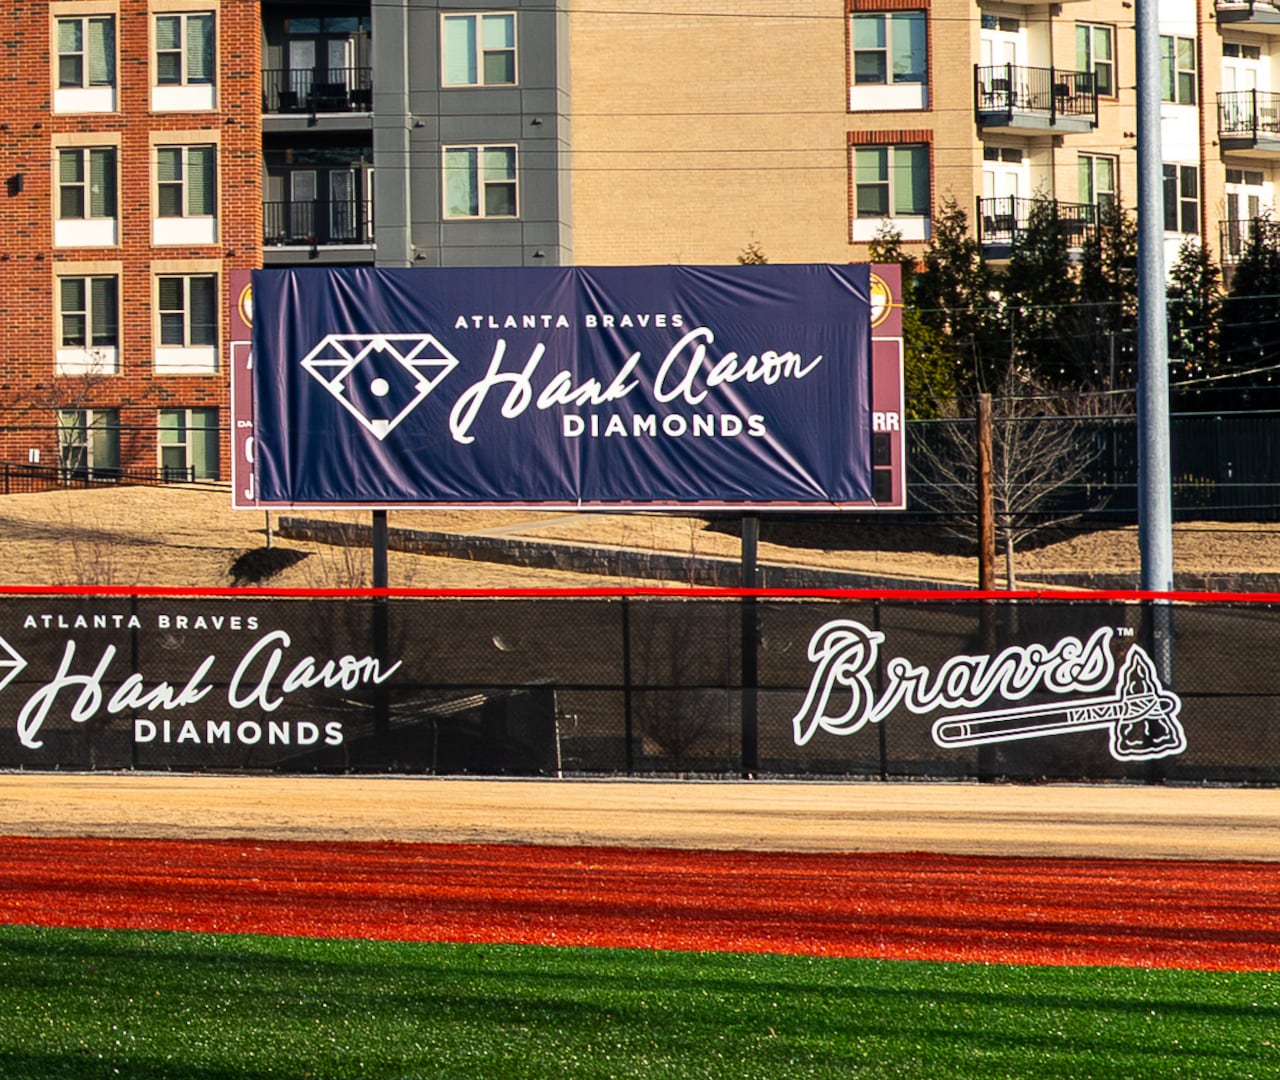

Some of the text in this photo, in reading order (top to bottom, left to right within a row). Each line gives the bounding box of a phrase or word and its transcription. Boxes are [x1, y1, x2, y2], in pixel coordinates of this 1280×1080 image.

[455, 314, 683, 329] ATLANTA BRAVES
[449, 327, 822, 444] Hank Aaron
[563, 414, 766, 437] DIAMONDS
[24, 615, 258, 629] ATLANTA BRAVES
[17, 630, 402, 748] Hank Aaron
[793, 620, 1114, 745] Braves
[135, 720, 344, 744] DIAMONDS
